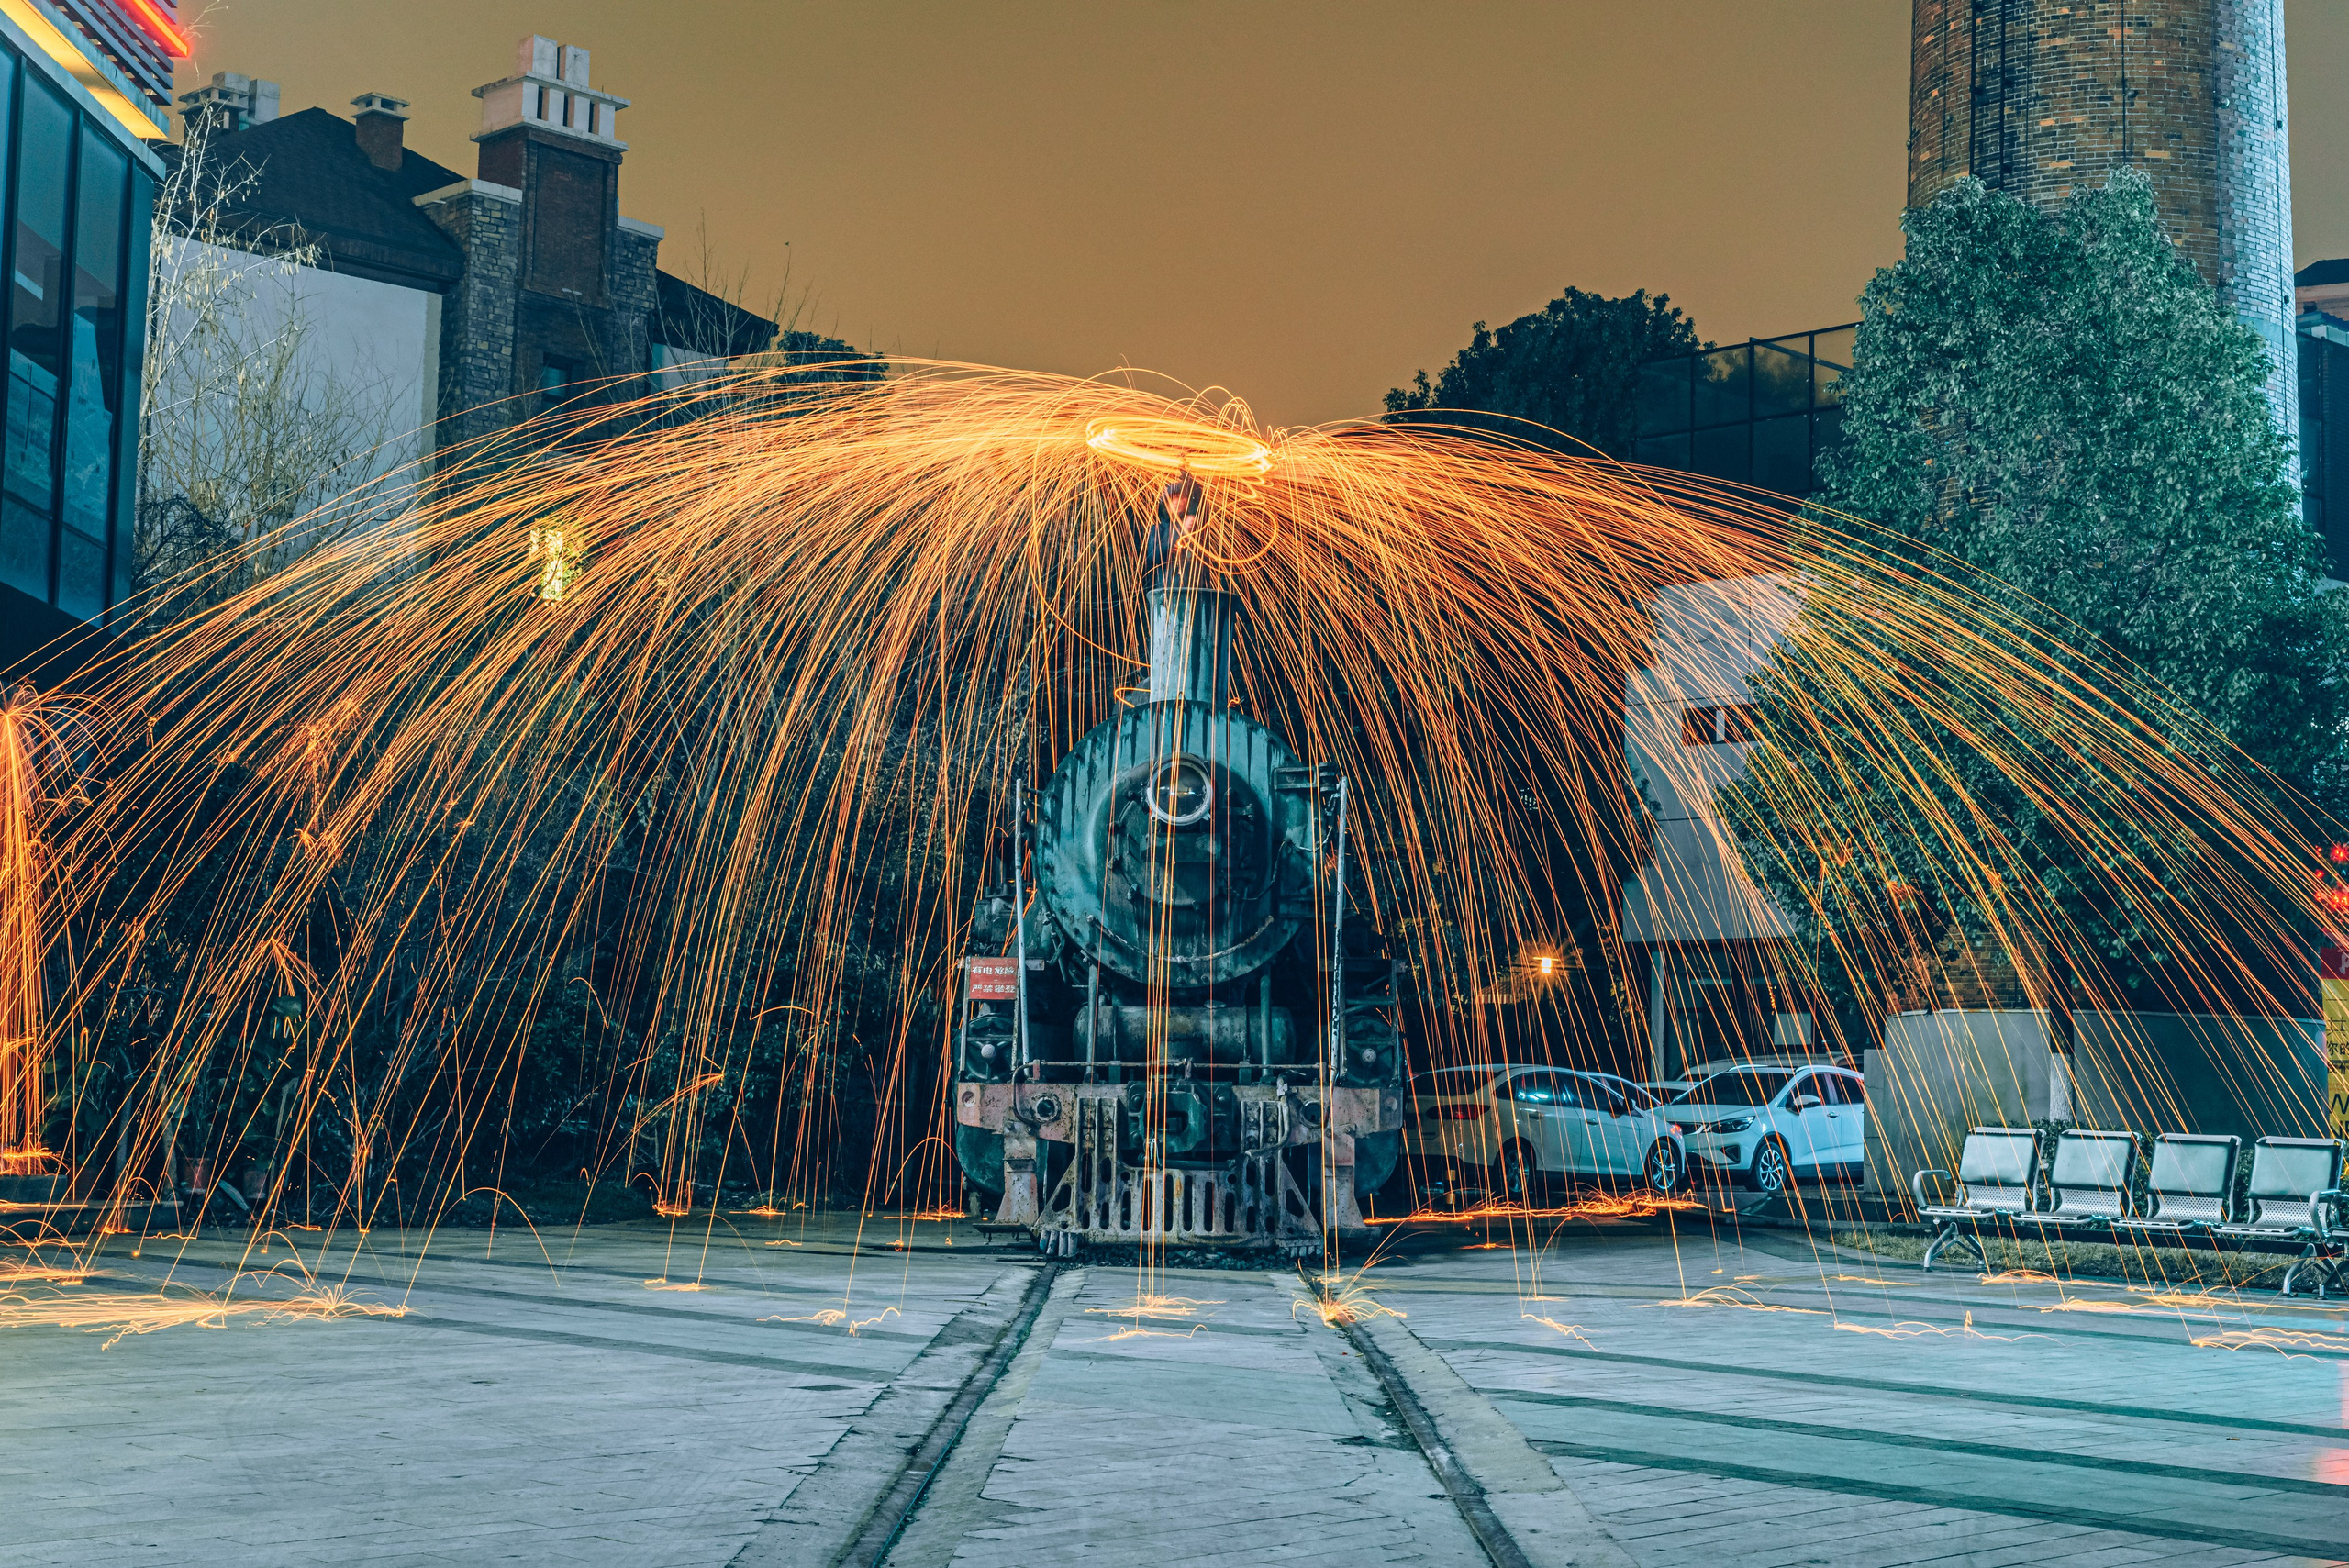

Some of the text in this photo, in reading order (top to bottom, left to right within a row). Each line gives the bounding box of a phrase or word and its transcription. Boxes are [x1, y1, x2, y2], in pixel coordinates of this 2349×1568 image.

[972, 966, 1015, 974] 有电危险
[972, 984, 1016, 993] 严禁攀登
